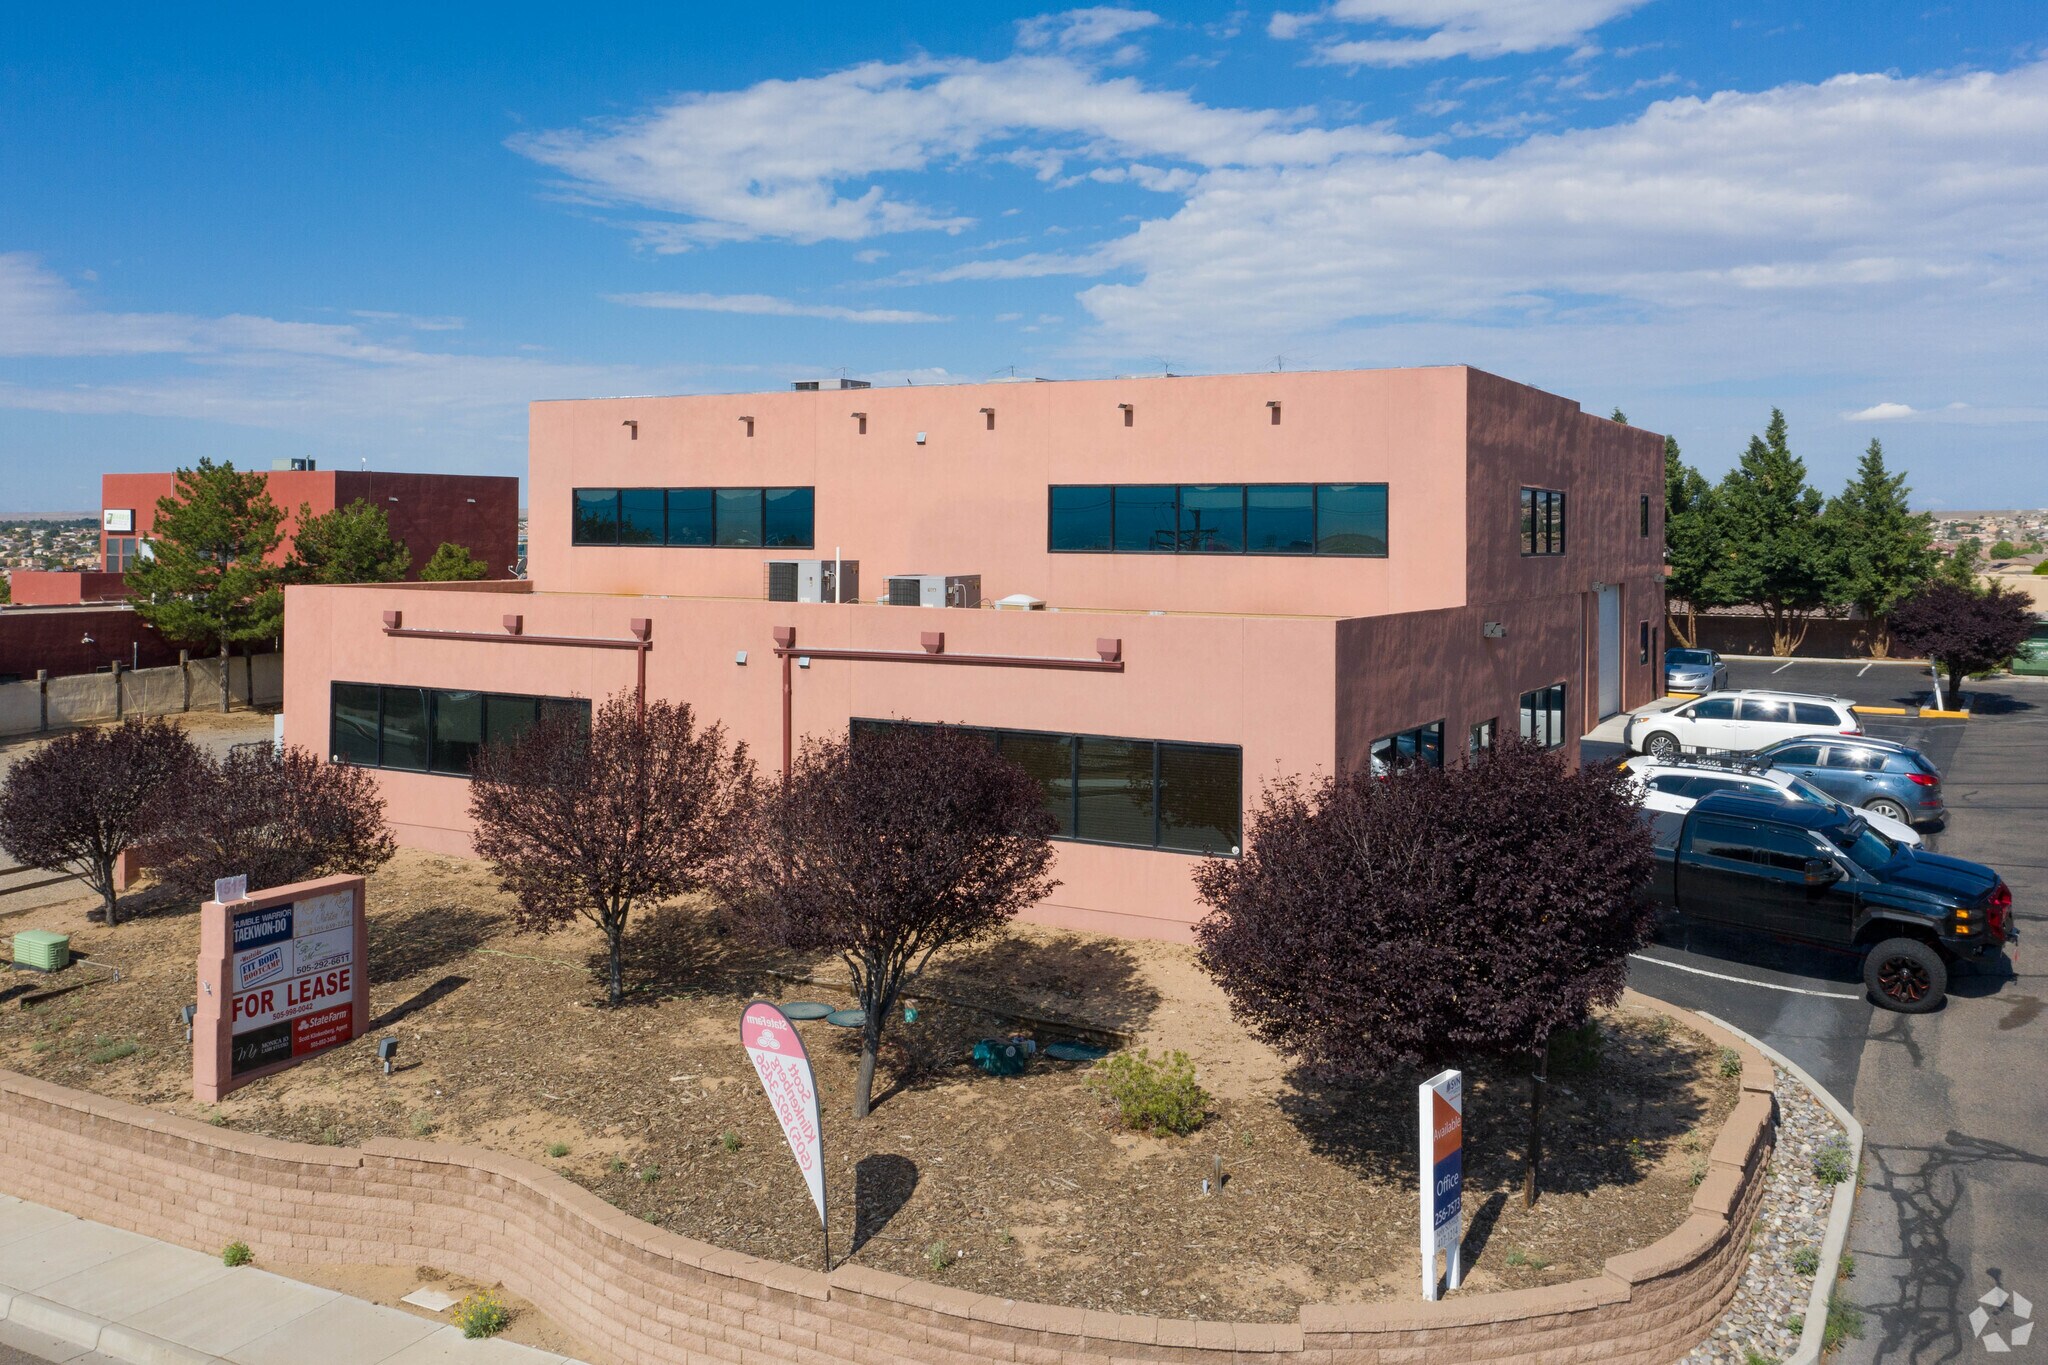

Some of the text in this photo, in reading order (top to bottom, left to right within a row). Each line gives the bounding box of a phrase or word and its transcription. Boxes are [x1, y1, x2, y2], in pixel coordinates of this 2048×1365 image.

[233, 916, 260, 929] HUMBLE
[261, 908, 292, 922] WARRIOR
[233, 917, 287, 943] TAEKWON-DO
[242, 950, 279, 974] FIT BODY
[243, 959, 281, 982] BOOTCAMP
[296, 954, 350, 974] 505-292-6611
[232, 989, 275, 1022] FOR
[287, 968, 350, 1007] LEASE
[272, 1003, 313, 1021] 505-998-0042
[1434, 1116, 1461, 1141] Available
[1436, 1172, 1459, 1197] Office
[1434, 1196, 1461, 1226] 256-7573
